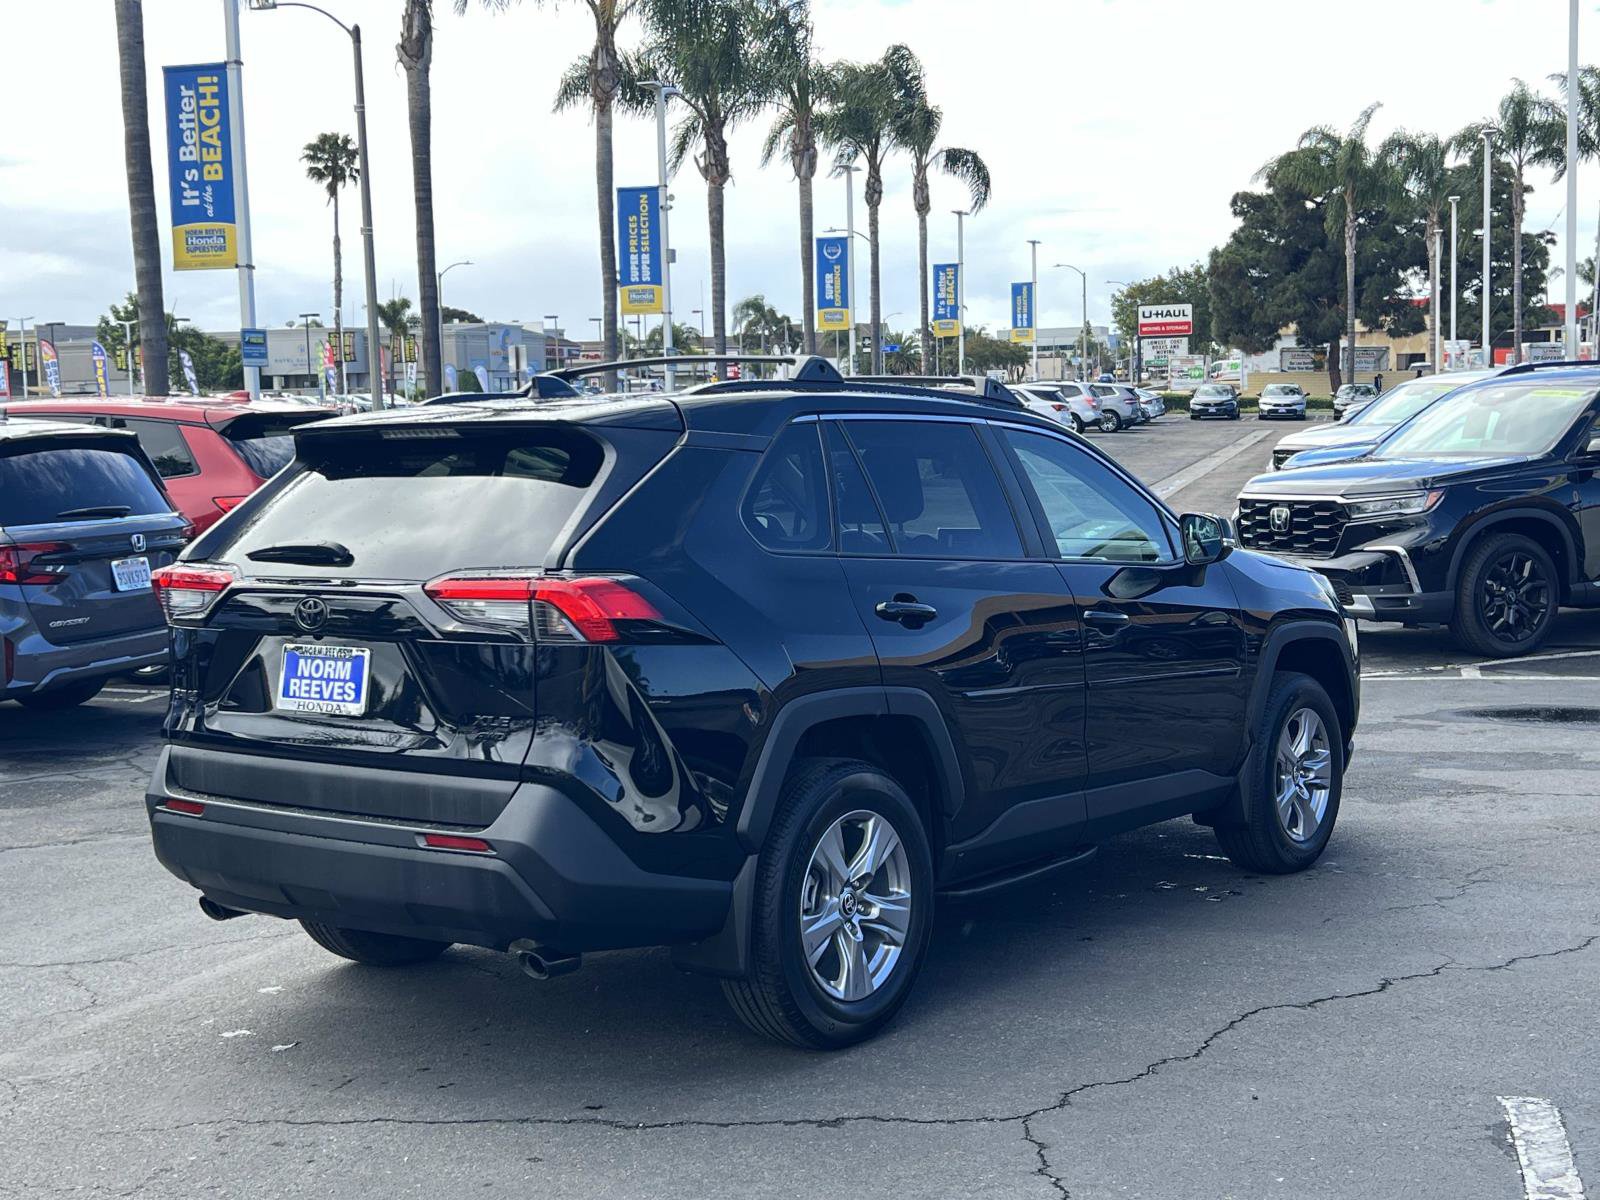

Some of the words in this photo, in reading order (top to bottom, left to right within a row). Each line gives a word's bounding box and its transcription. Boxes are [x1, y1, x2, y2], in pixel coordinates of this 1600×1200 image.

[179, 85, 197, 162] Better
[197, 76, 224, 181] BEACH!
[181, 168, 200, 206] It's
[202, 184, 213, 201] the
[202, 202, 214, 217] at
[640, 194, 649, 252] SELECTION
[187, 236, 225, 245] Honda
[629, 215, 638, 252] PRICES
[630, 254, 639, 282] SUPER
[642, 253, 650, 281] SUPER
[825, 273, 833, 300] SUPER
[937, 271, 946, 299] Better
[946, 268, 955, 305] BEACH!
[937, 300, 946, 314] It's
[297, 659, 352, 680] NORM
[289, 679, 356, 702] REEVES
[297, 701, 342, 713] HONDA
